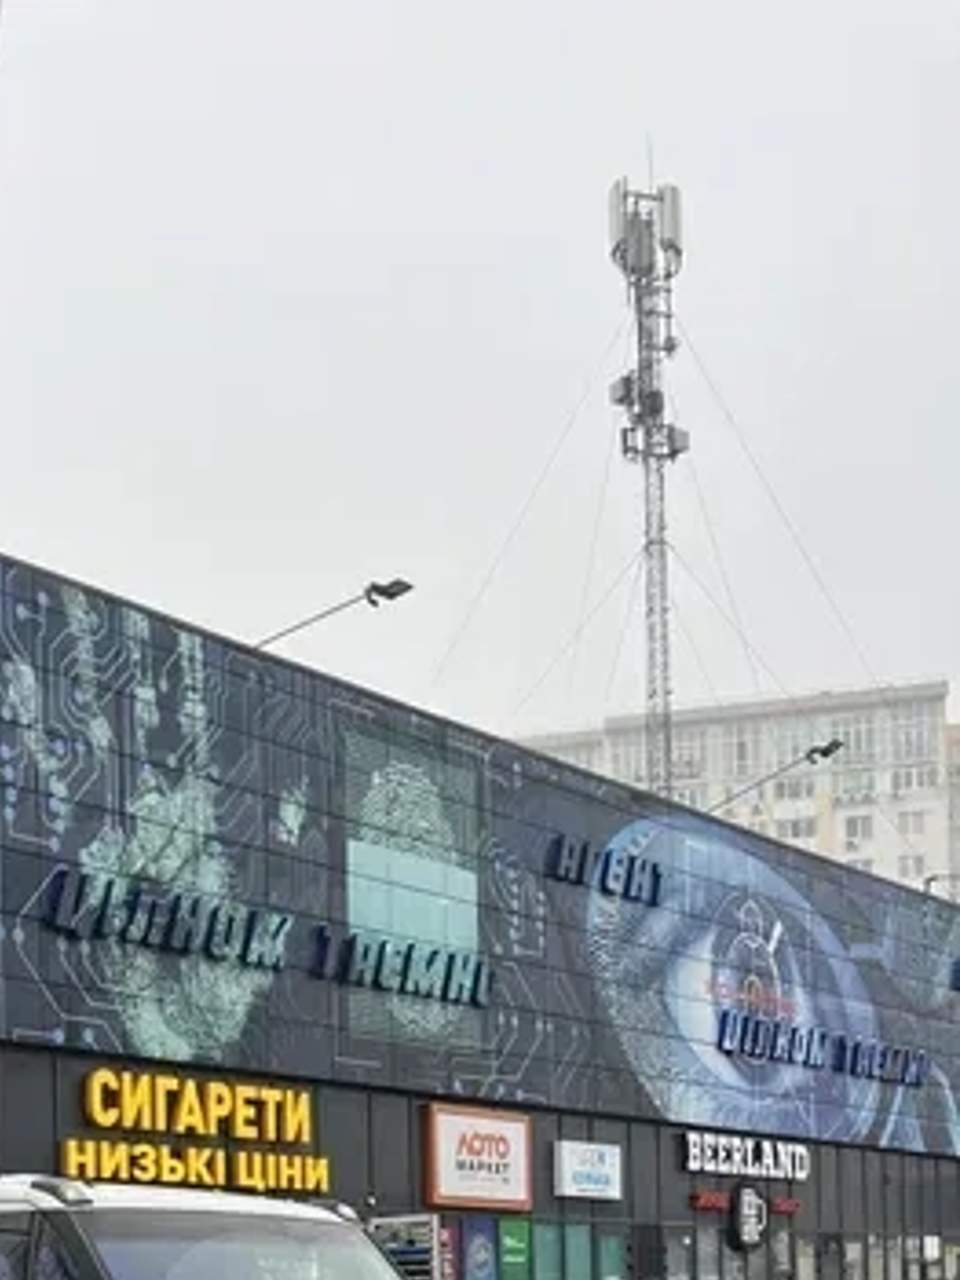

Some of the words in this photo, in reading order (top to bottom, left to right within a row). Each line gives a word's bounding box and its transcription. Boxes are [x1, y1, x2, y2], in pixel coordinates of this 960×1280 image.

[86, 1067, 312, 1143] СИГАРЕТИ
[64, 1139, 227, 1186] НИЗЬКІ
[237, 1150, 329, 1193] ЦІНИ
[686, 1132, 810, 1180] BEERLAND
